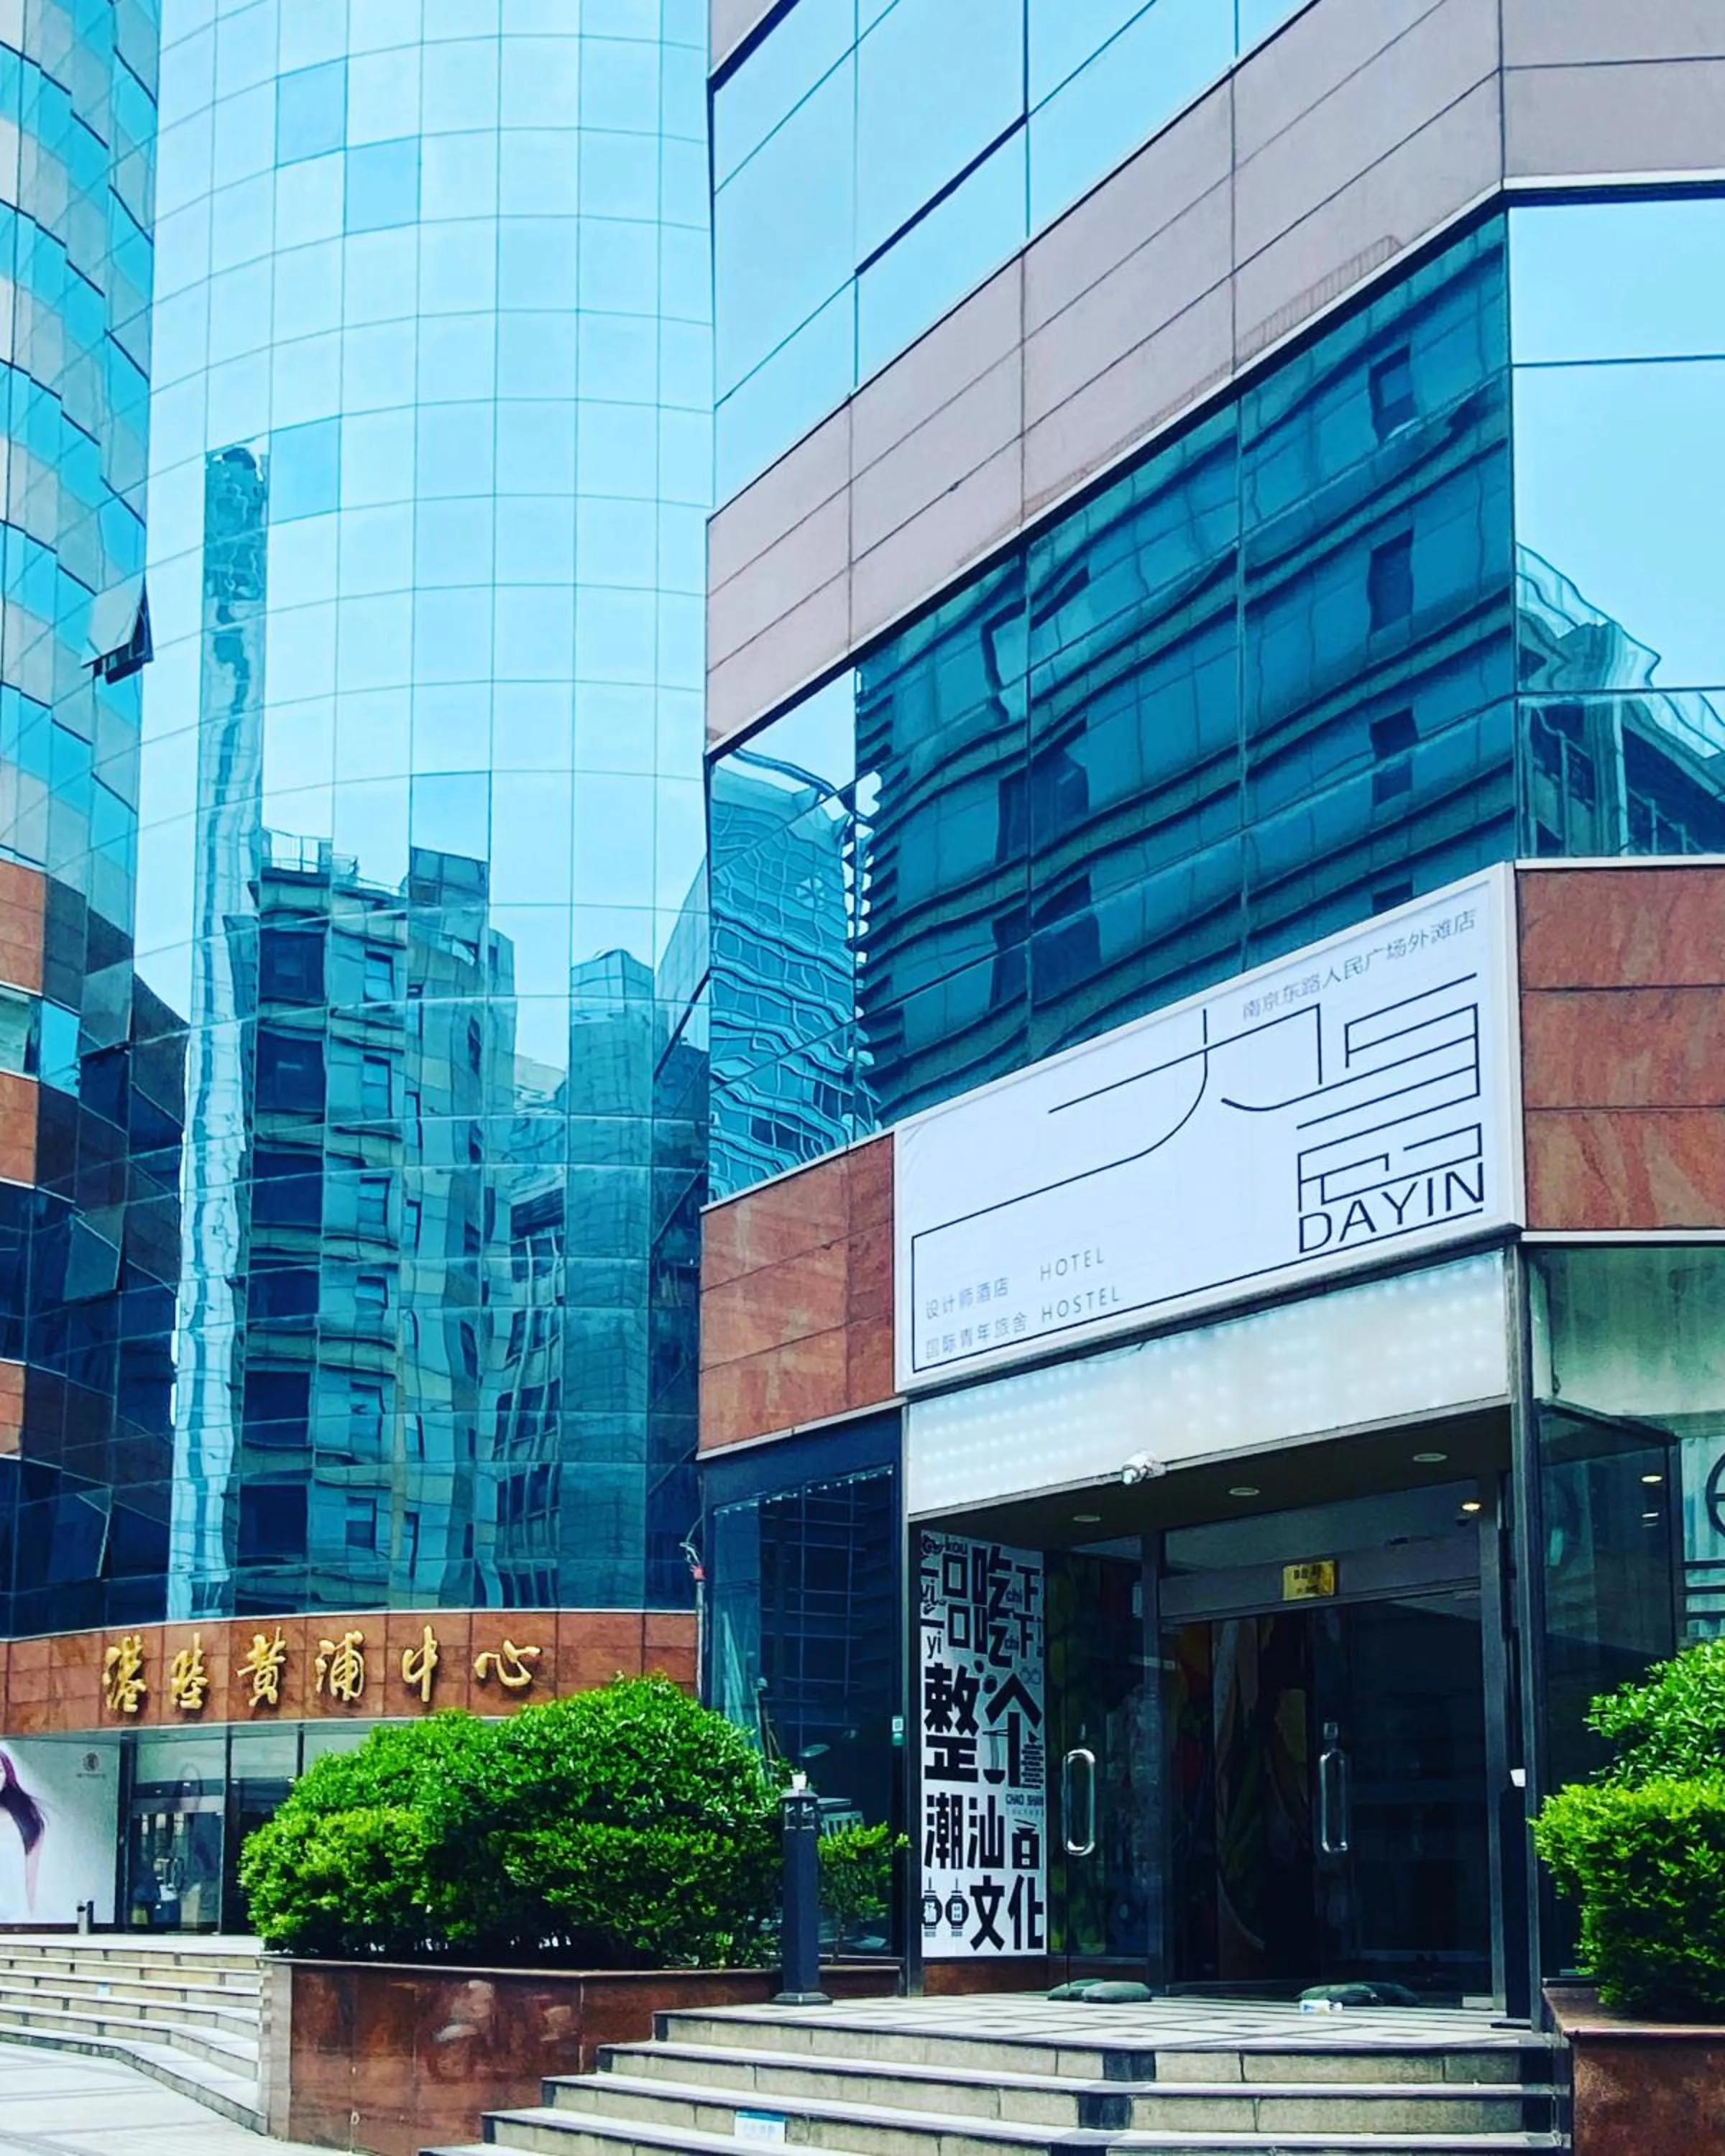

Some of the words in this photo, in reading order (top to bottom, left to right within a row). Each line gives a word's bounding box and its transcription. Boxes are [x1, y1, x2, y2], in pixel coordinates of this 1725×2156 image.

[1242, 908, 1477, 1020] 南京东路人民广场外滩店
[1297, 1161, 1484, 1256] DAYIN
[926, 1276, 1010, 1320] 设计师酒店
[1039, 1247, 1105, 1281] HOTEL
[1041, 1285, 1121, 1323] HOSTEL
[924, 1664, 1042, 1789] 整个
[924, 1792, 1005, 1870] 潮汕
[969, 1874, 1044, 1952] 文化
